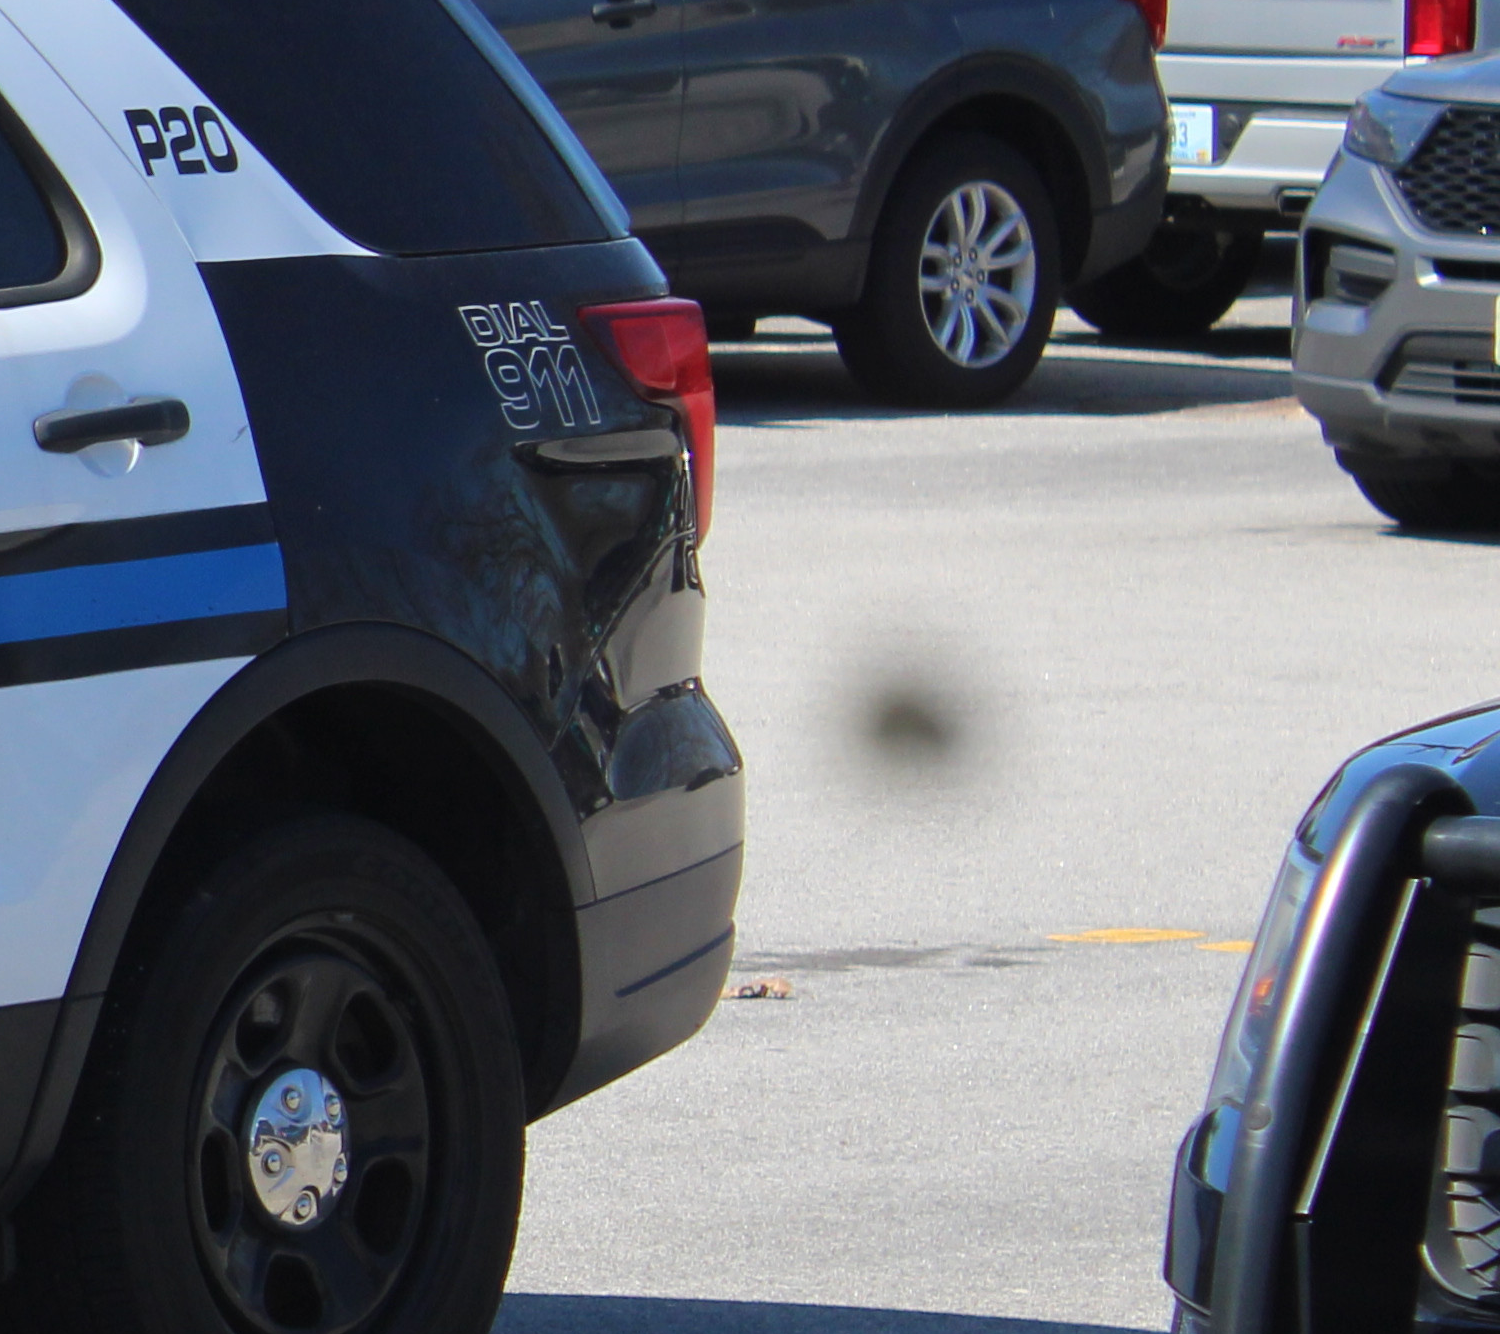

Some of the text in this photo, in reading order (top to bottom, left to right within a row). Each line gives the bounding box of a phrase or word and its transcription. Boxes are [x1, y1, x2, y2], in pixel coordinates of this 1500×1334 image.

[124, 104, 238, 176] P20
[458, 299, 569, 347] DIAL
[483, 344, 601, 430] 911
